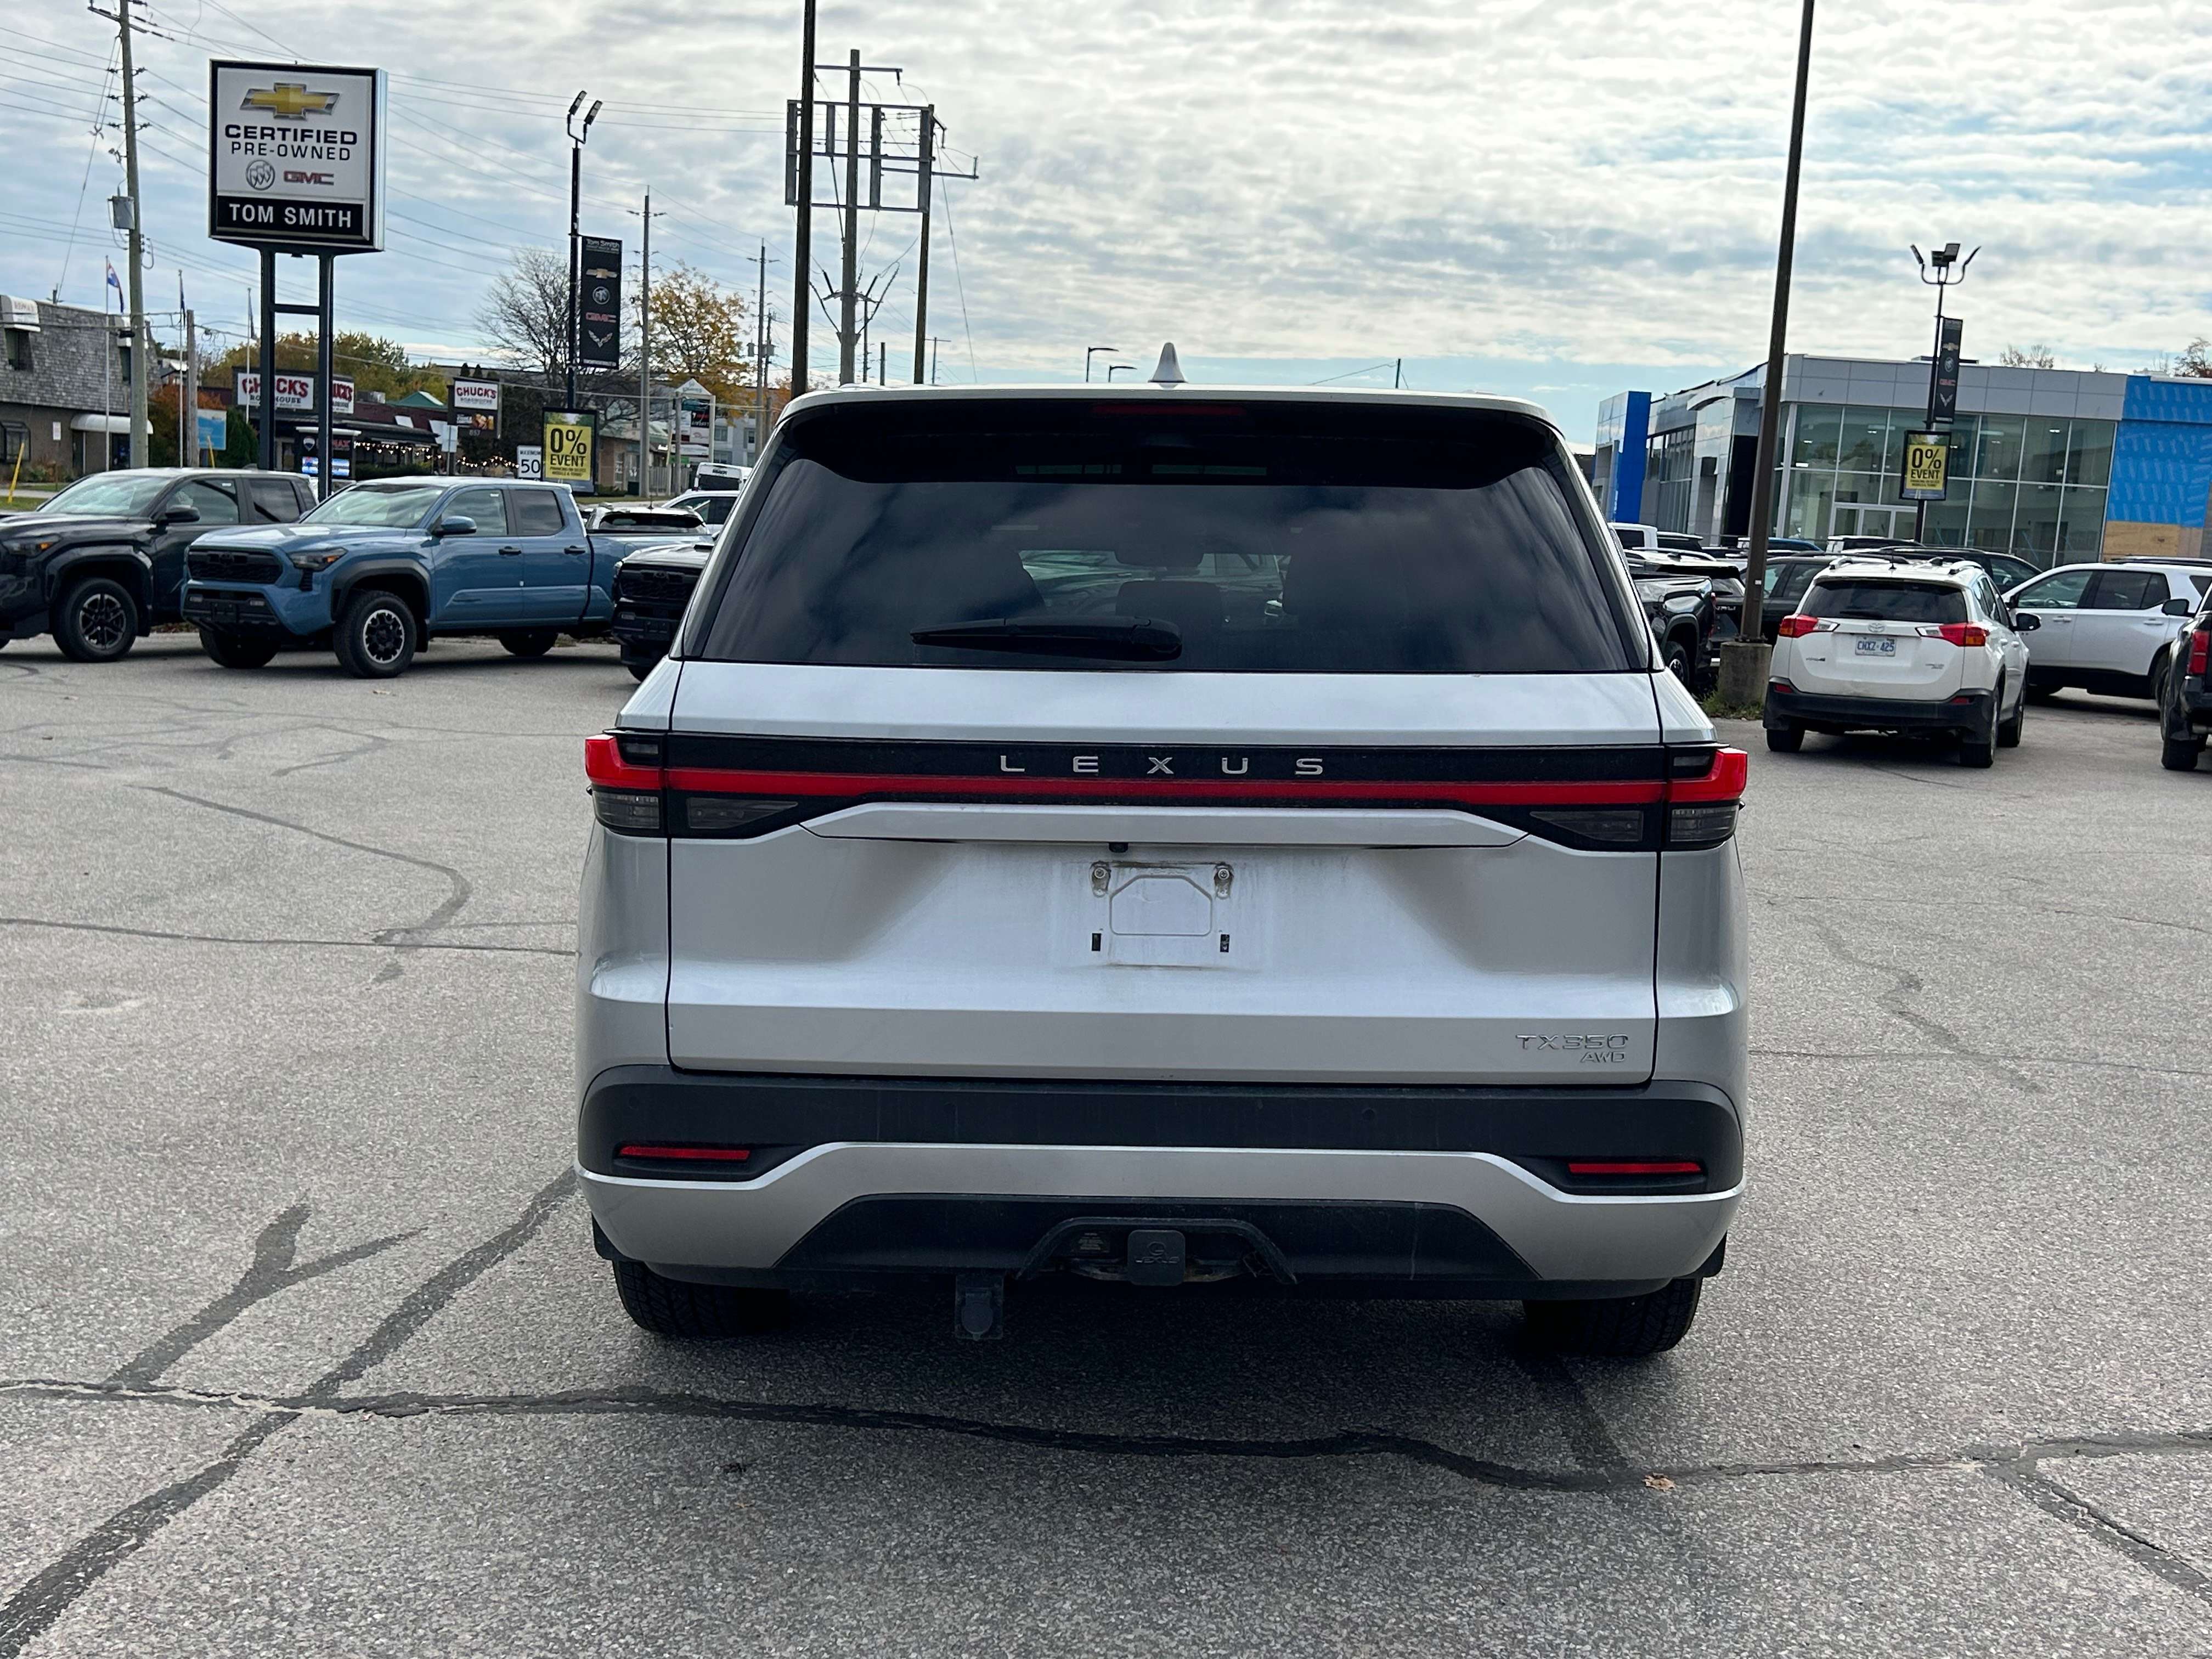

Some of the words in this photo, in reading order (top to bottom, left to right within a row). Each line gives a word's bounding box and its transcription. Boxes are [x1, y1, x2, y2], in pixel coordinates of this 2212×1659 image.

[225, 124, 357, 145] CERTIFIED
[231, 141, 351, 161] PRE-OWNED
[284, 171, 334, 186] GMC
[229, 204, 274, 223] TOM
[285, 206, 352, 228] SMITH
[585, 312, 617, 323] GMC
[242, 377, 309, 398] CHCK'S
[456, 387, 496, 399] CHUCK'S
[550, 428, 587, 455] 0%
[521, 459, 540, 473] 50
[550, 454, 586, 467] EVENT
[1912, 448, 1942, 469] 0%
[1911, 469, 1940, 479] EVENT
[1880, 642, 1895, 652] 425
[1000, 755, 1323, 775] LEXUS
[1515, 1034, 1628, 1050] TX350
[1580, 1051, 1626, 1063] AWD
